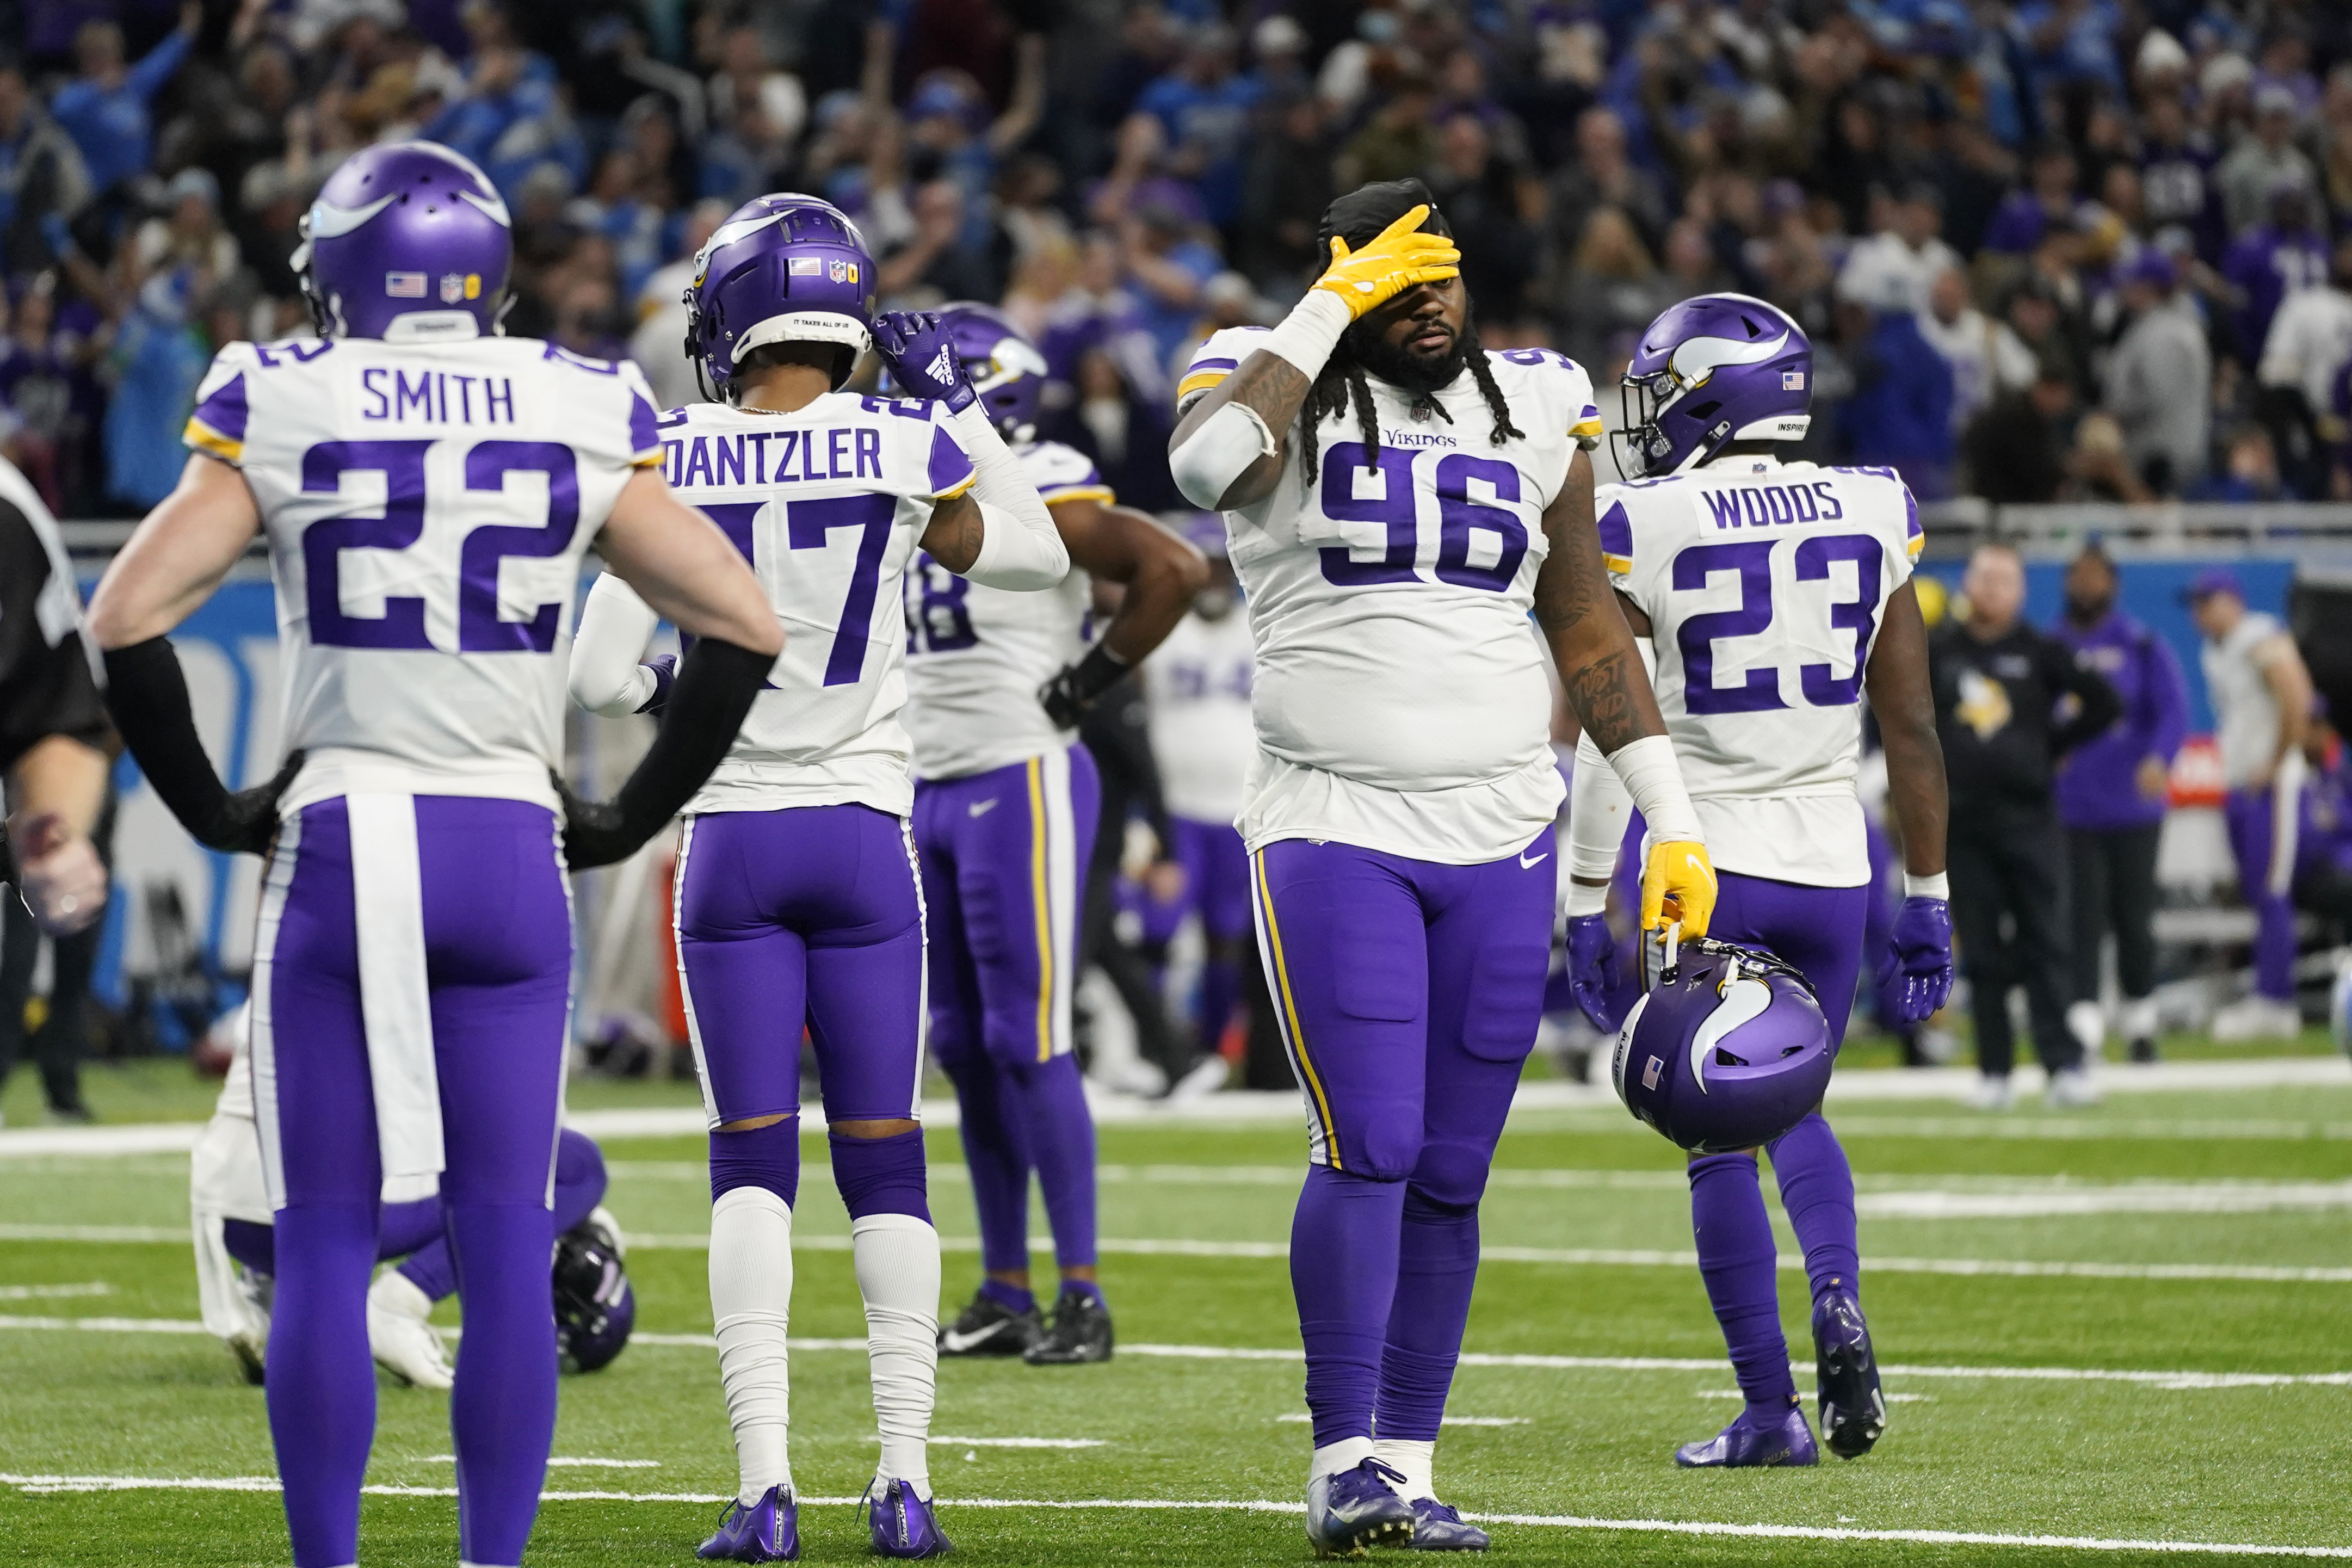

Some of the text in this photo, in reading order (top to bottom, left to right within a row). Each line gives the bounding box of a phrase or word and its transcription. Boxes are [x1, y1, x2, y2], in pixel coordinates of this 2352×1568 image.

[941, 343, 954, 386] adidas
[362, 368, 514, 425] SMITH
[1777, 423, 1805, 432] INSPIRE
[662, 428, 883, 488] DANTZLER
[1317, 441, 1528, 592] 96
[1701, 482, 1842, 529] WOODS
[302, 440, 580, 654] 22
[903, 552, 981, 655] 8
[1672, 534, 1884, 715] 23
[1616, 1031, 1627, 1064] BLACK
